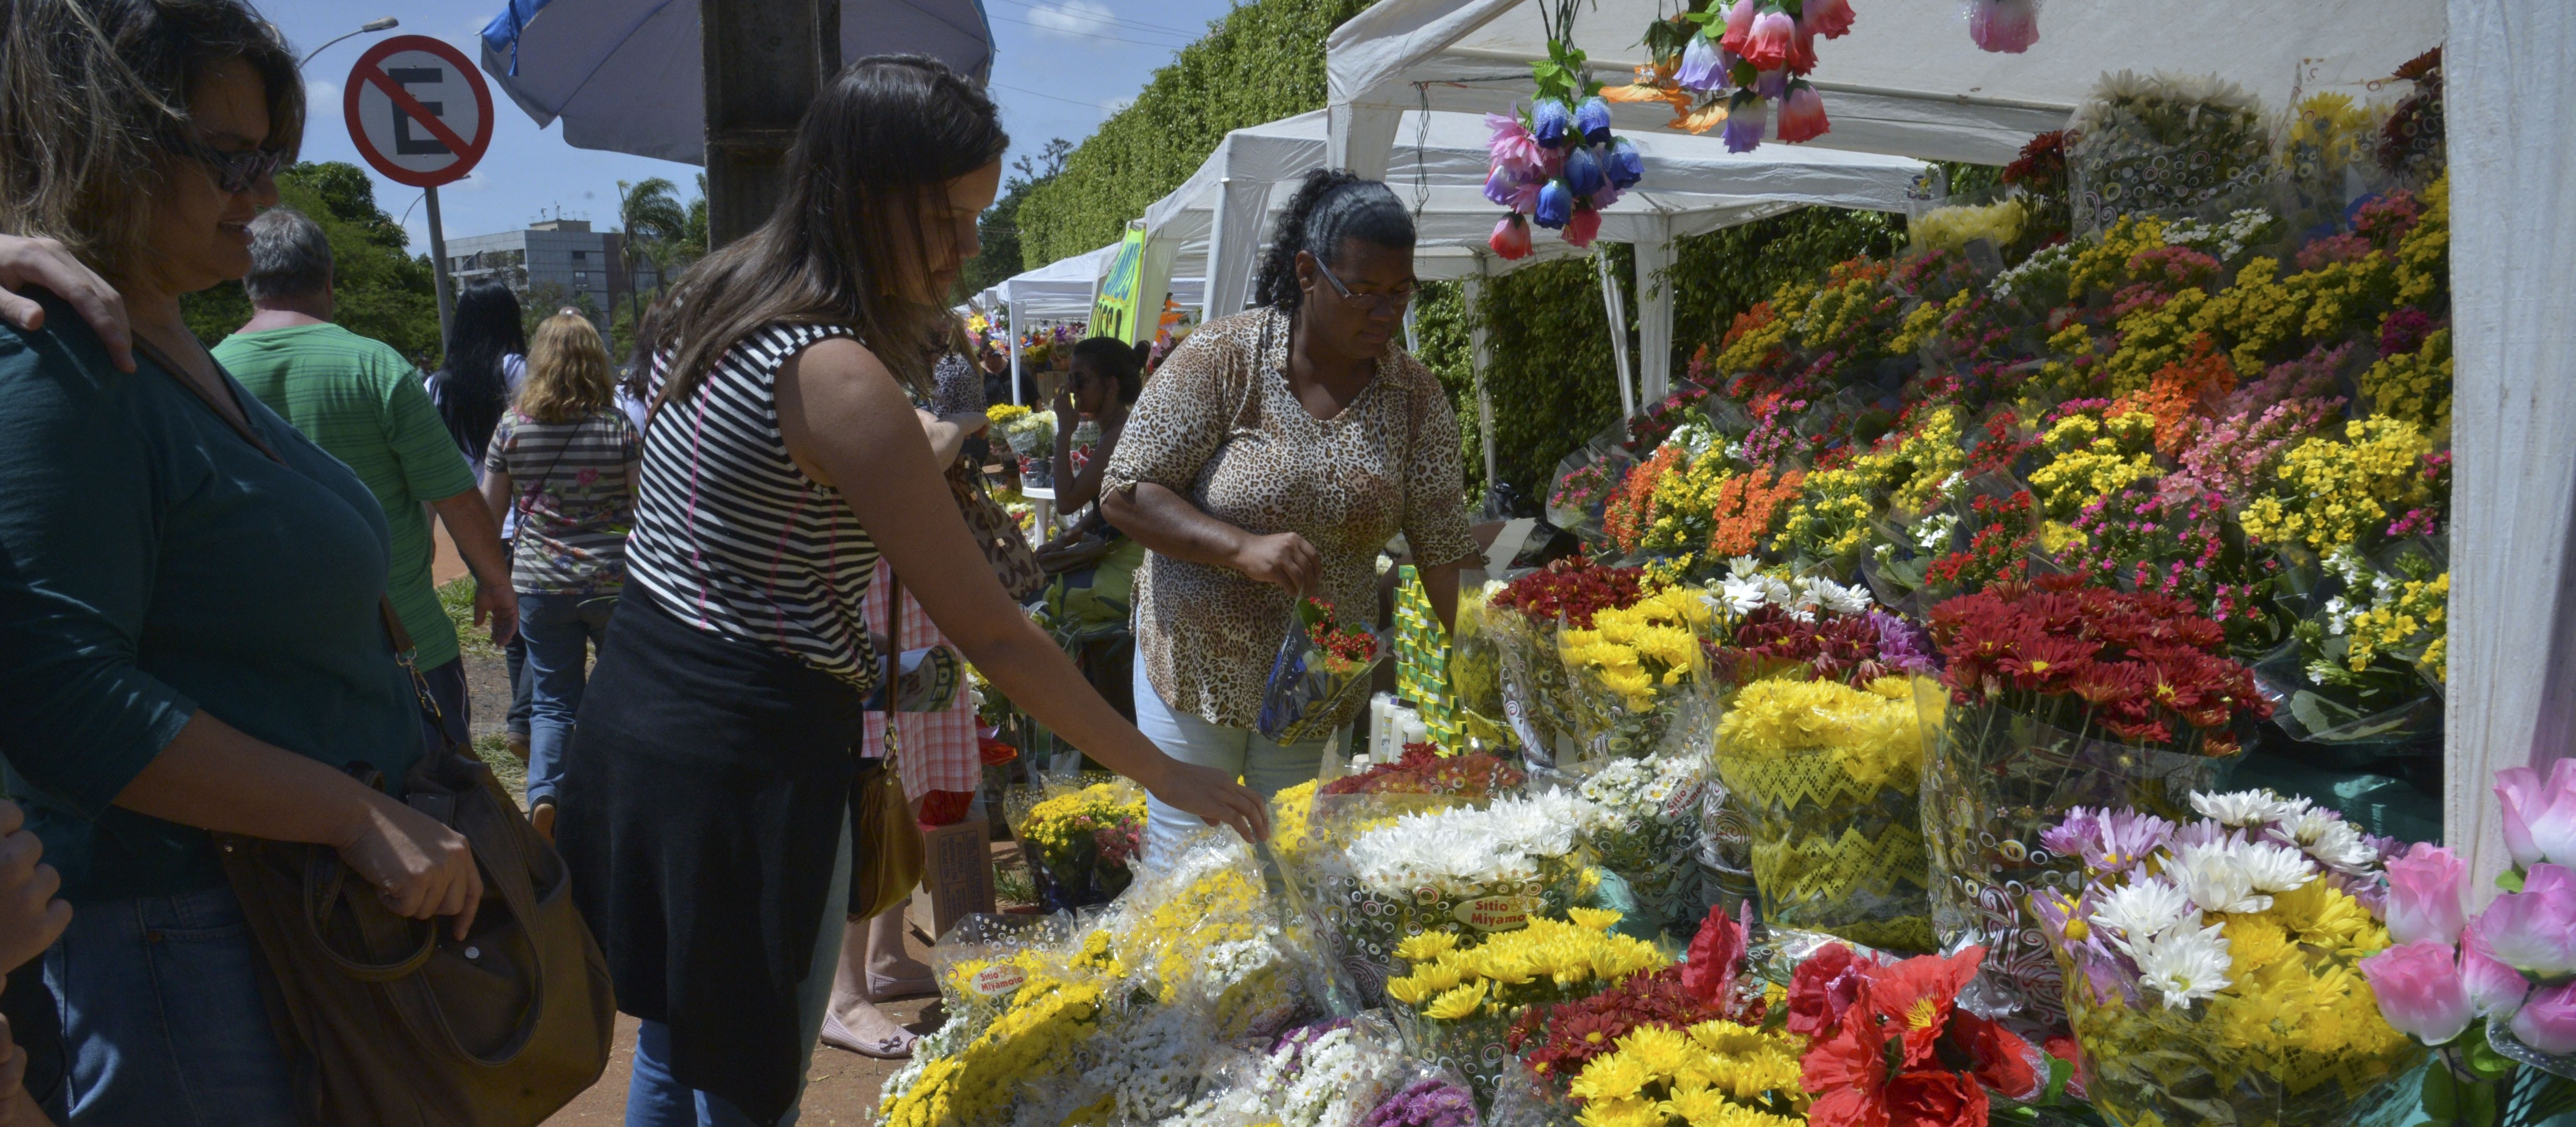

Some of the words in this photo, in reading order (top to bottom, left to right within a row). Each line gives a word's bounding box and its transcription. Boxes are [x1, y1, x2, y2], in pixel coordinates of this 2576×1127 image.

[388, 68, 451, 155] E
[1475, 900, 1509, 912] Sítio
[980, 971, 999, 982] Sítio
[981, 976, 1024, 992] Miyamoto
